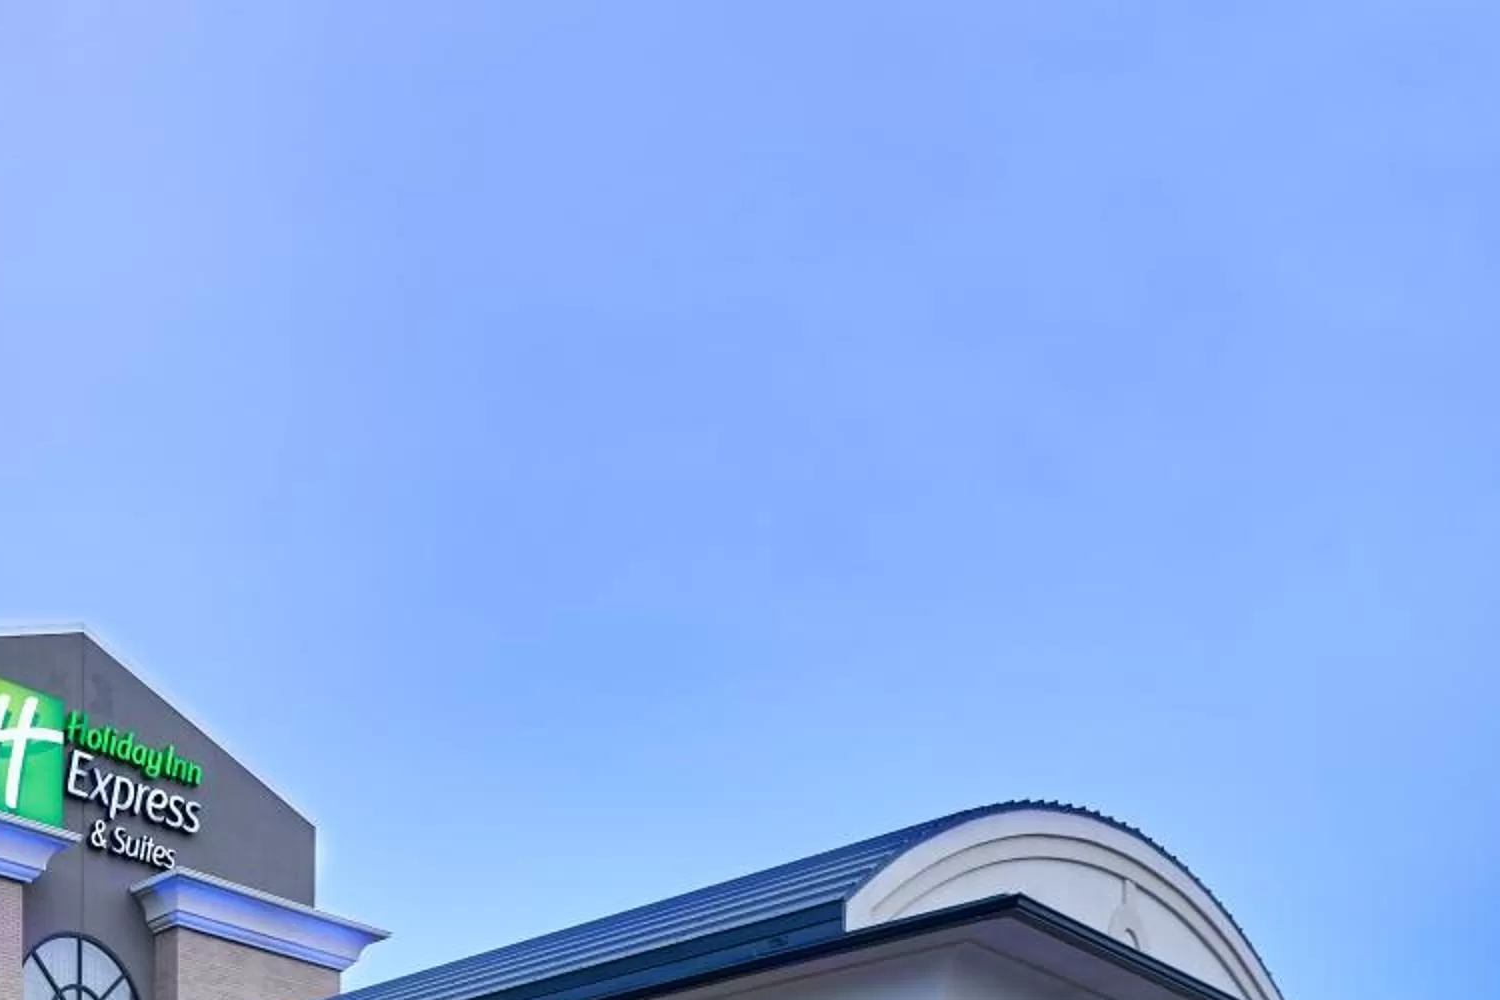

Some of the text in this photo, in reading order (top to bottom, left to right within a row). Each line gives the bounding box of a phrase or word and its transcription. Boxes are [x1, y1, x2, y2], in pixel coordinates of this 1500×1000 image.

[67, 710, 202, 785] Holiday Inn
[67, 749, 202, 833] Express
[91, 819, 177, 870] & Suites
